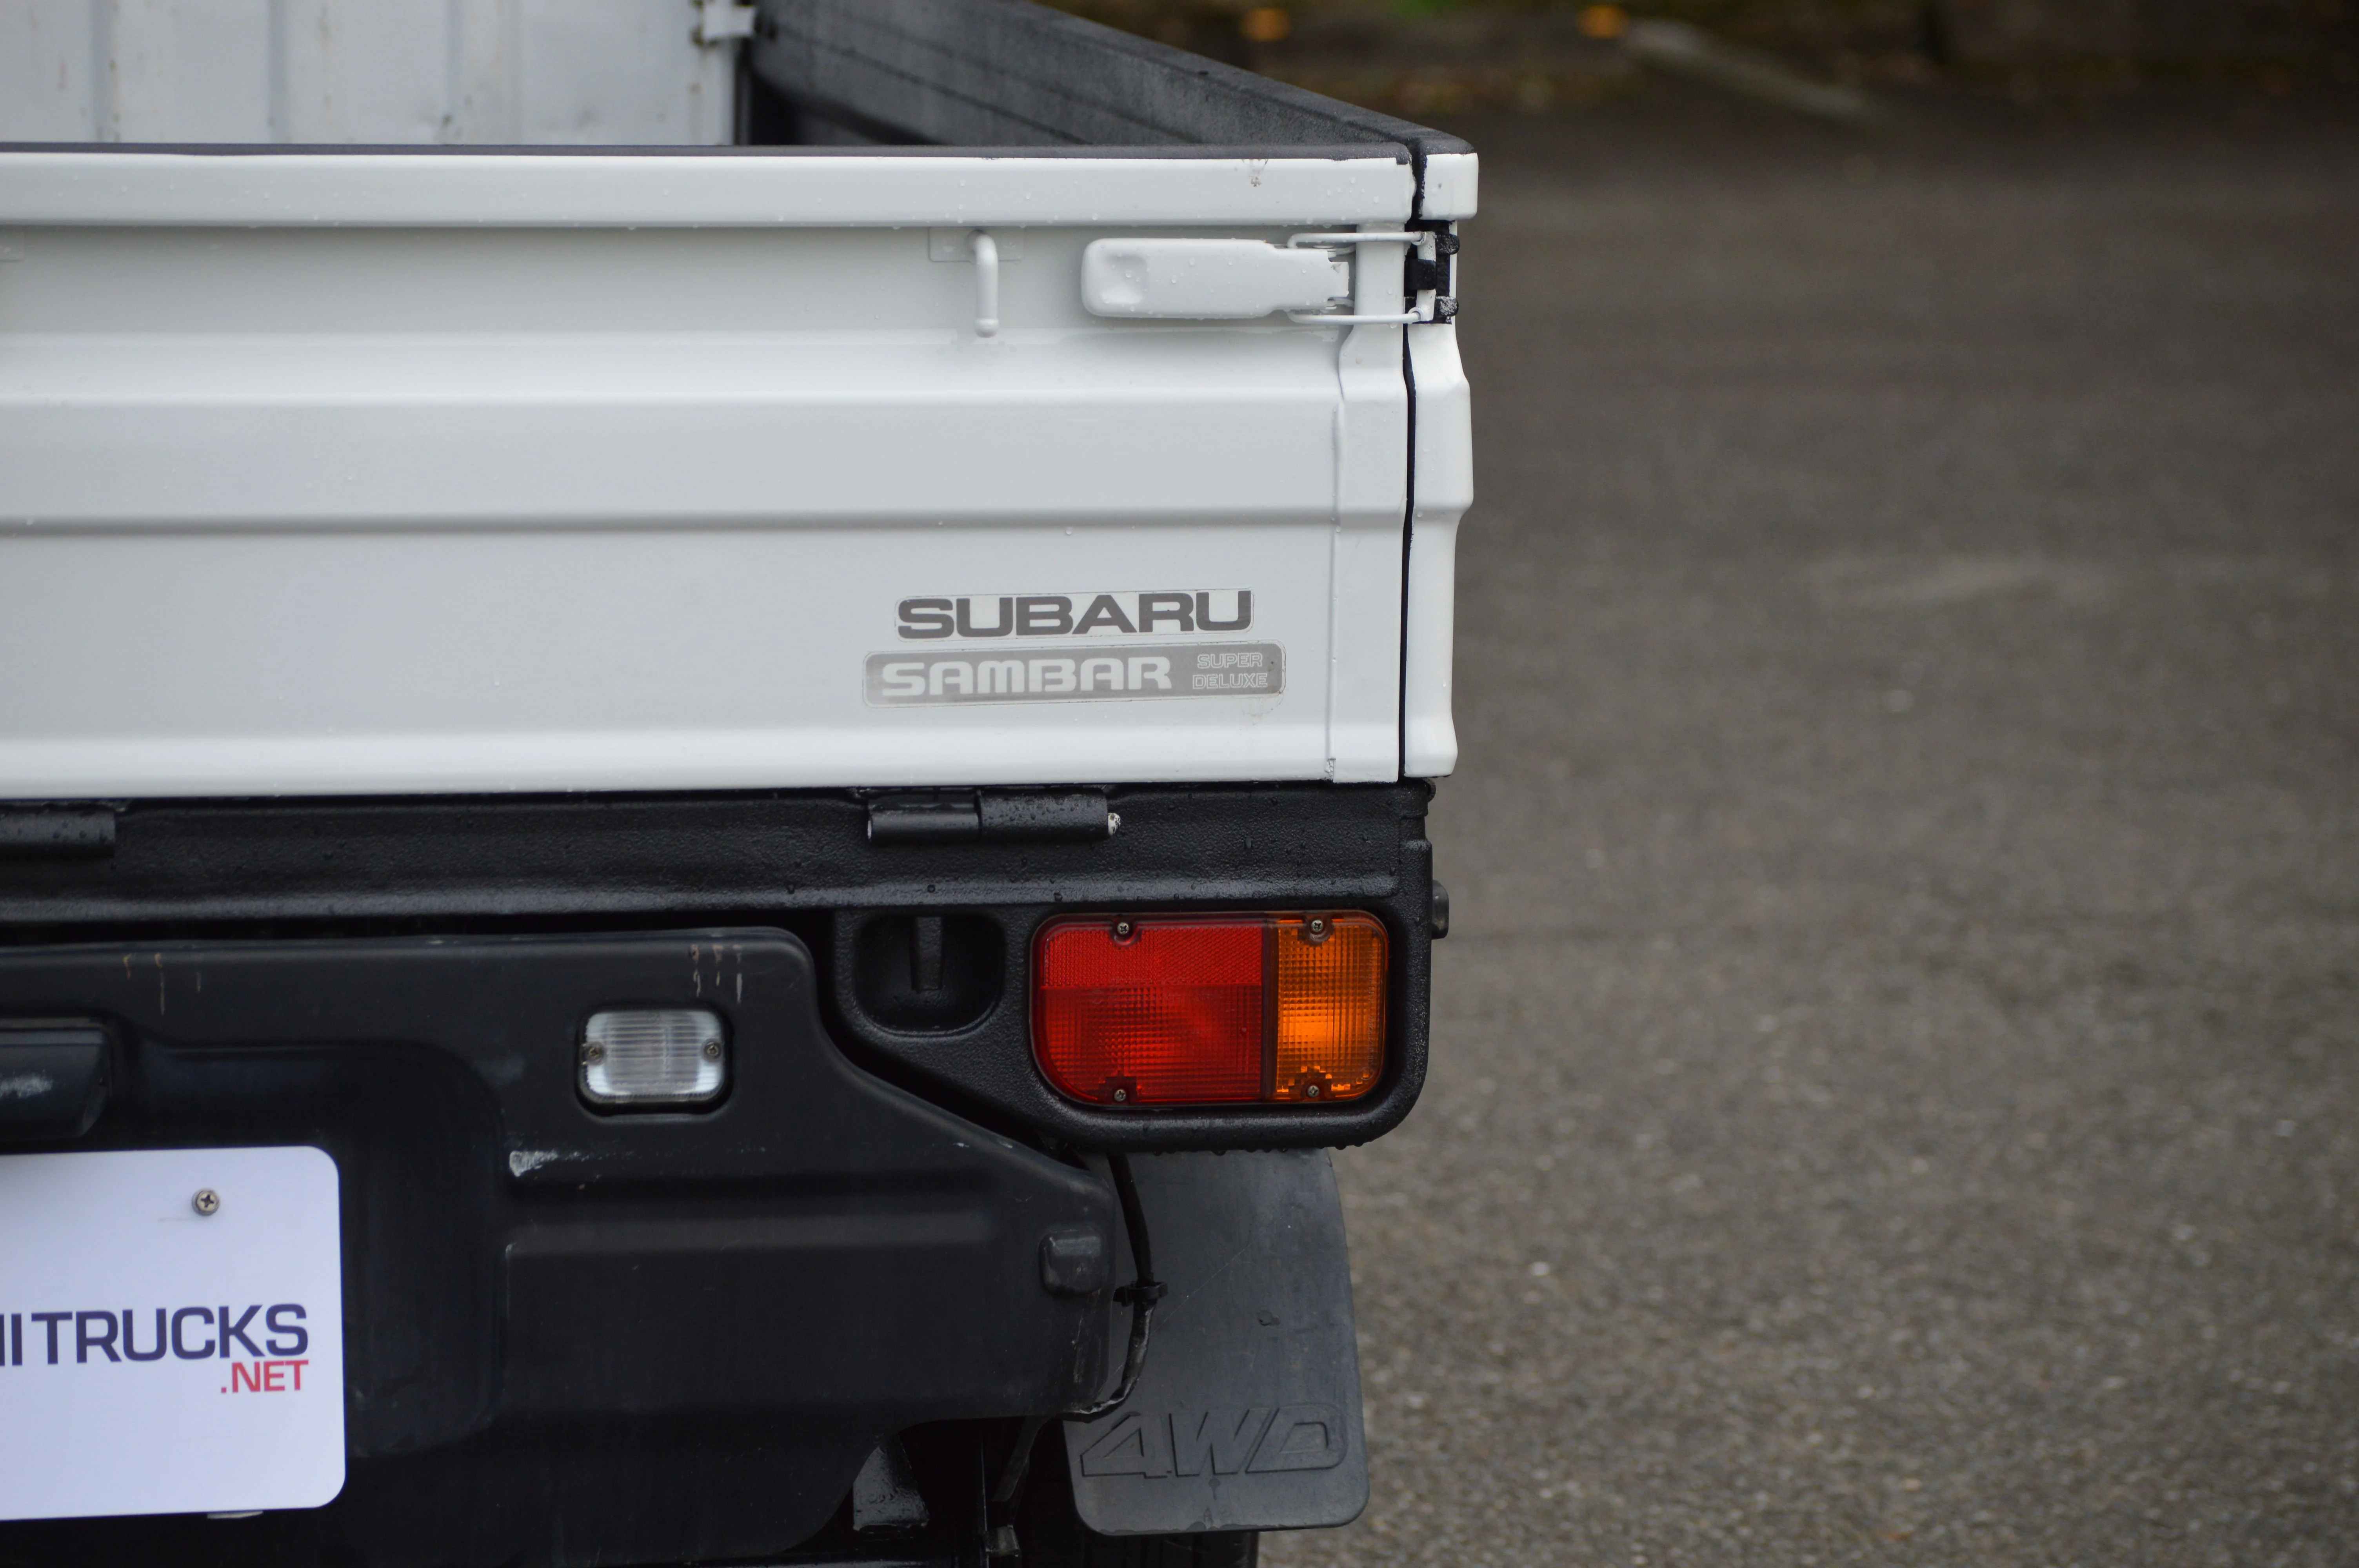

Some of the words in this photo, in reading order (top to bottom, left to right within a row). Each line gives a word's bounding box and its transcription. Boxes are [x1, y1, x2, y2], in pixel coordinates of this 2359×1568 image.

[898, 590, 1251, 639] SUBARU
[881, 657, 1172, 697] SAMBAR
[1197, 652, 1263, 669] SUPER
[1192, 672, 1268, 690] DELUXE
[0, 1304, 308, 1367] ITRUCKS
[221, 1359, 309, 1393] .NET
[1080, 1403, 1348, 1479] 4WD
